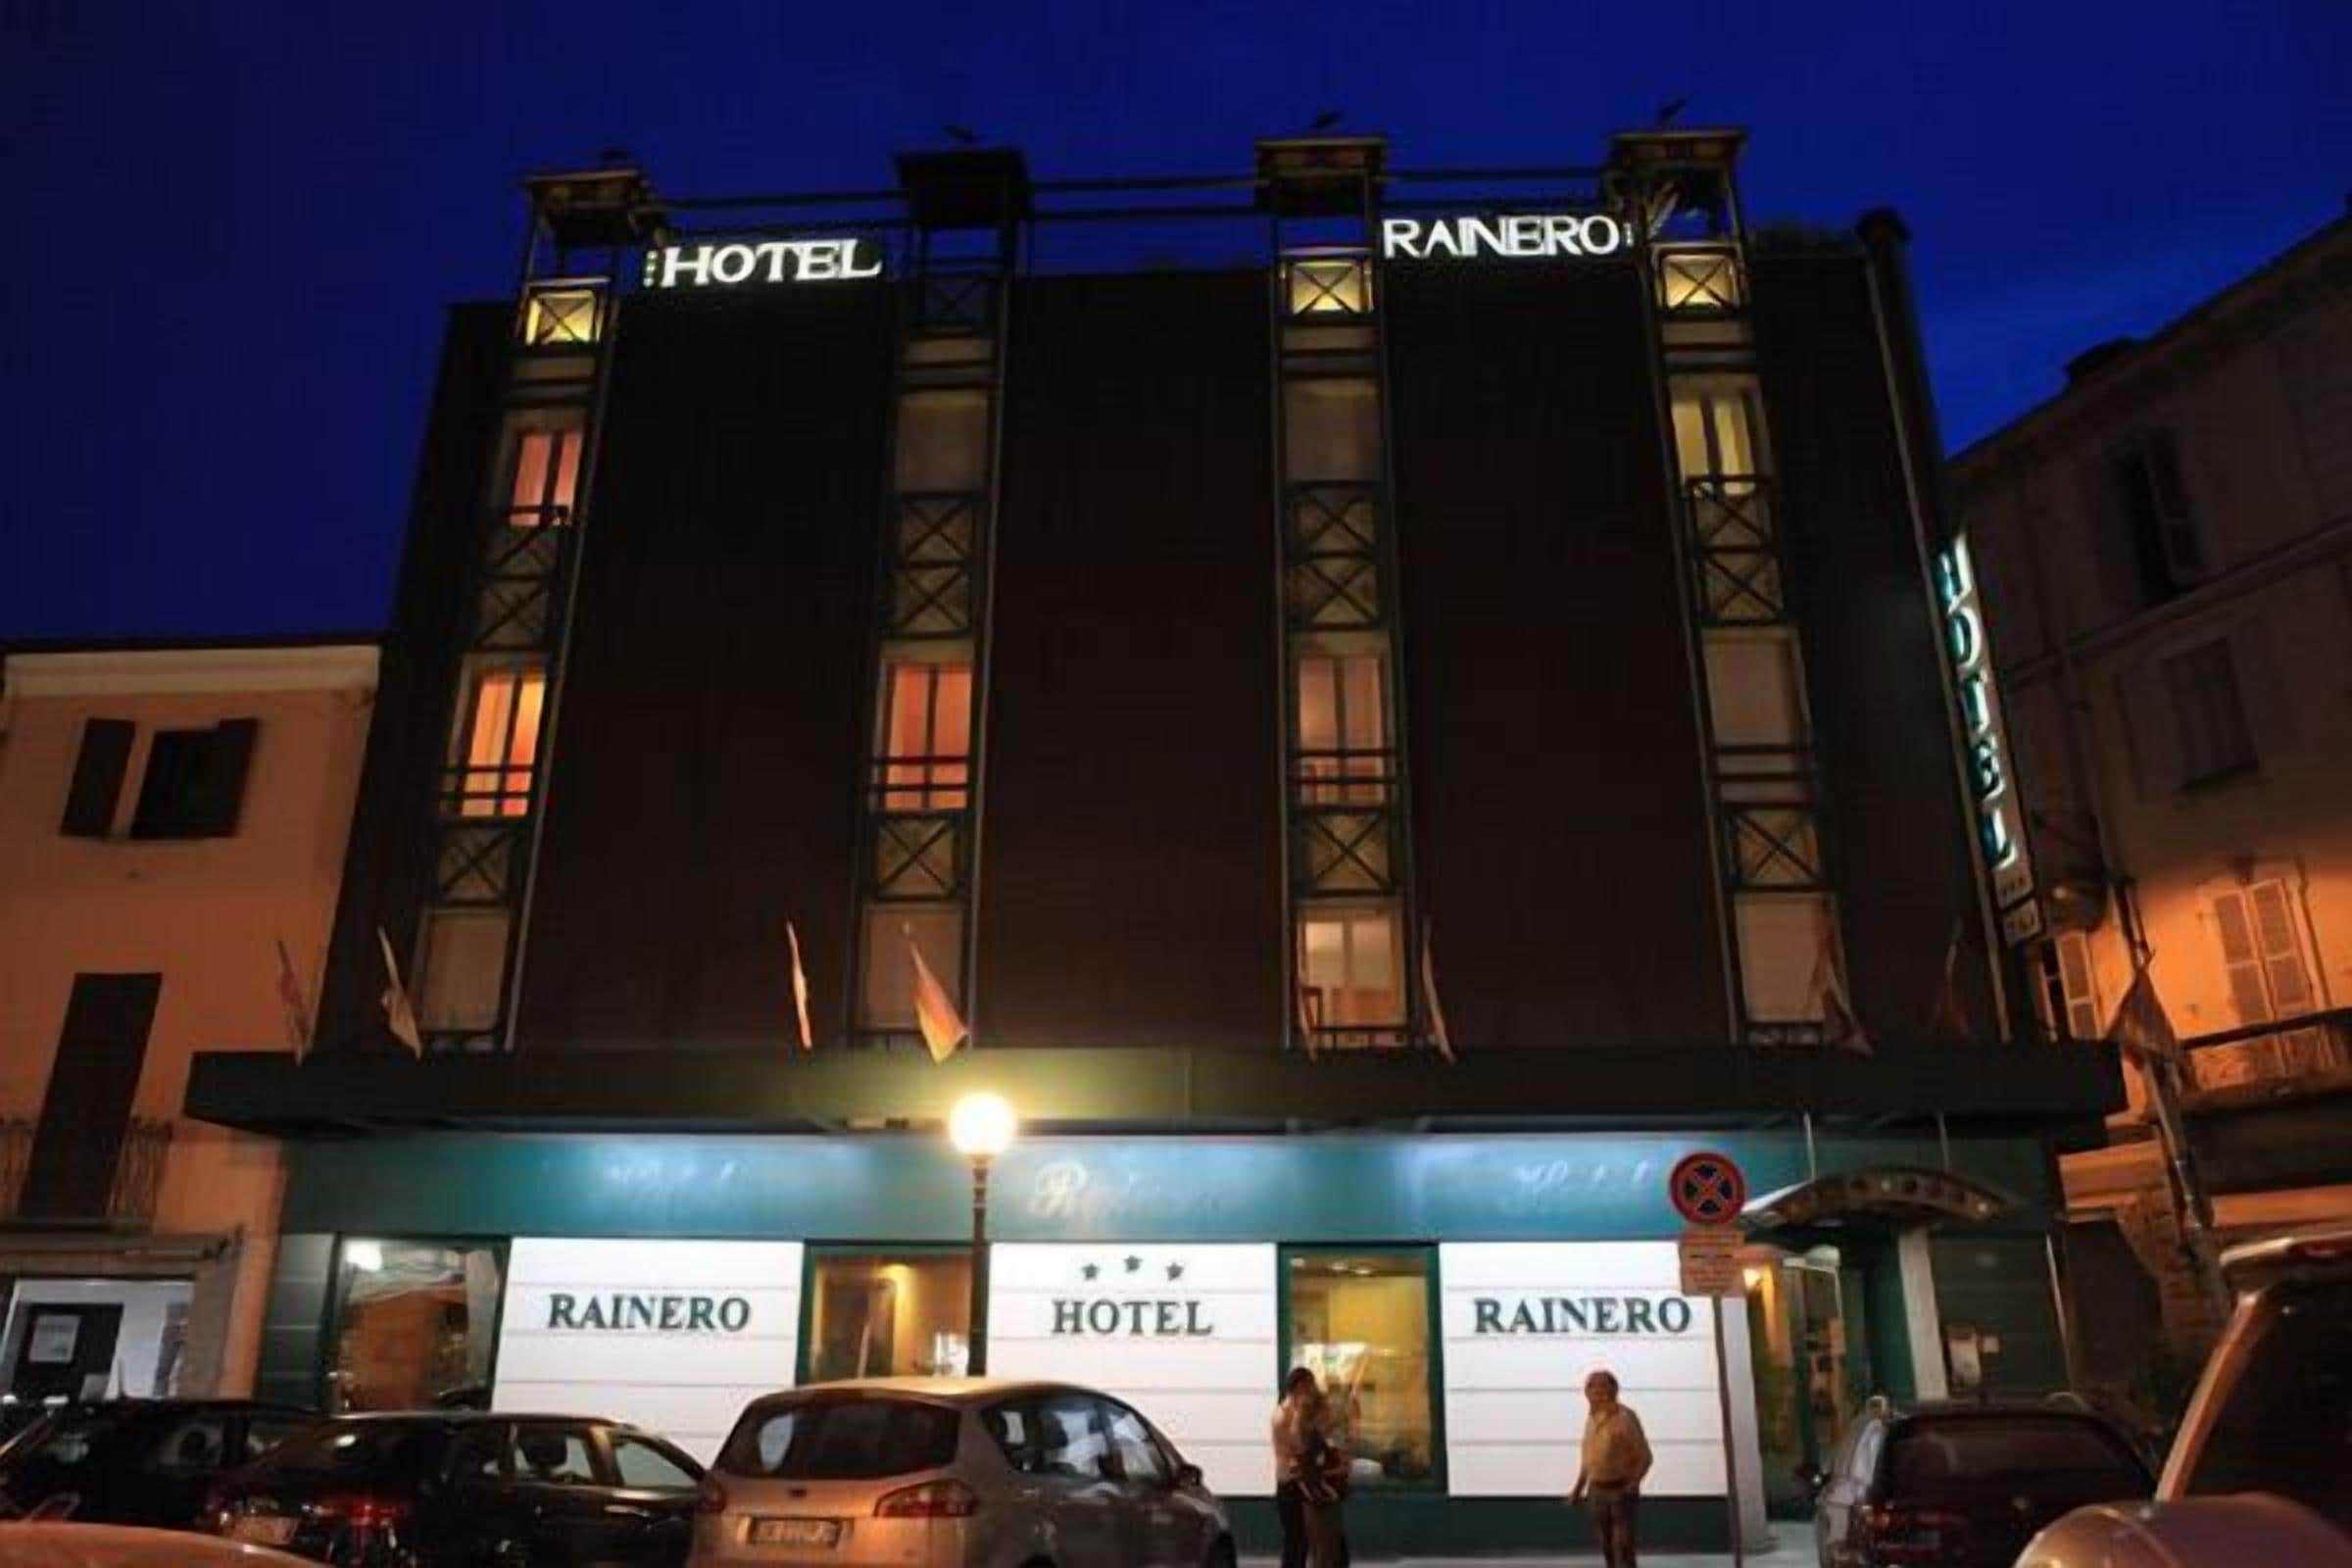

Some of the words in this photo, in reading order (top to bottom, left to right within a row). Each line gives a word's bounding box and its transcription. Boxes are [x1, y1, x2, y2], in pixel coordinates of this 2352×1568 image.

[661, 238, 881, 287] HOTEL
[1382, 215, 1620, 259] RAINERO
[1935, 532, 2019, 870] HOTEL
[548, 1294, 752, 1332] RAINERO
[1051, 1298, 1213, 1337] HOTEL
[1473, 1297, 1692, 1335] RAINERO
